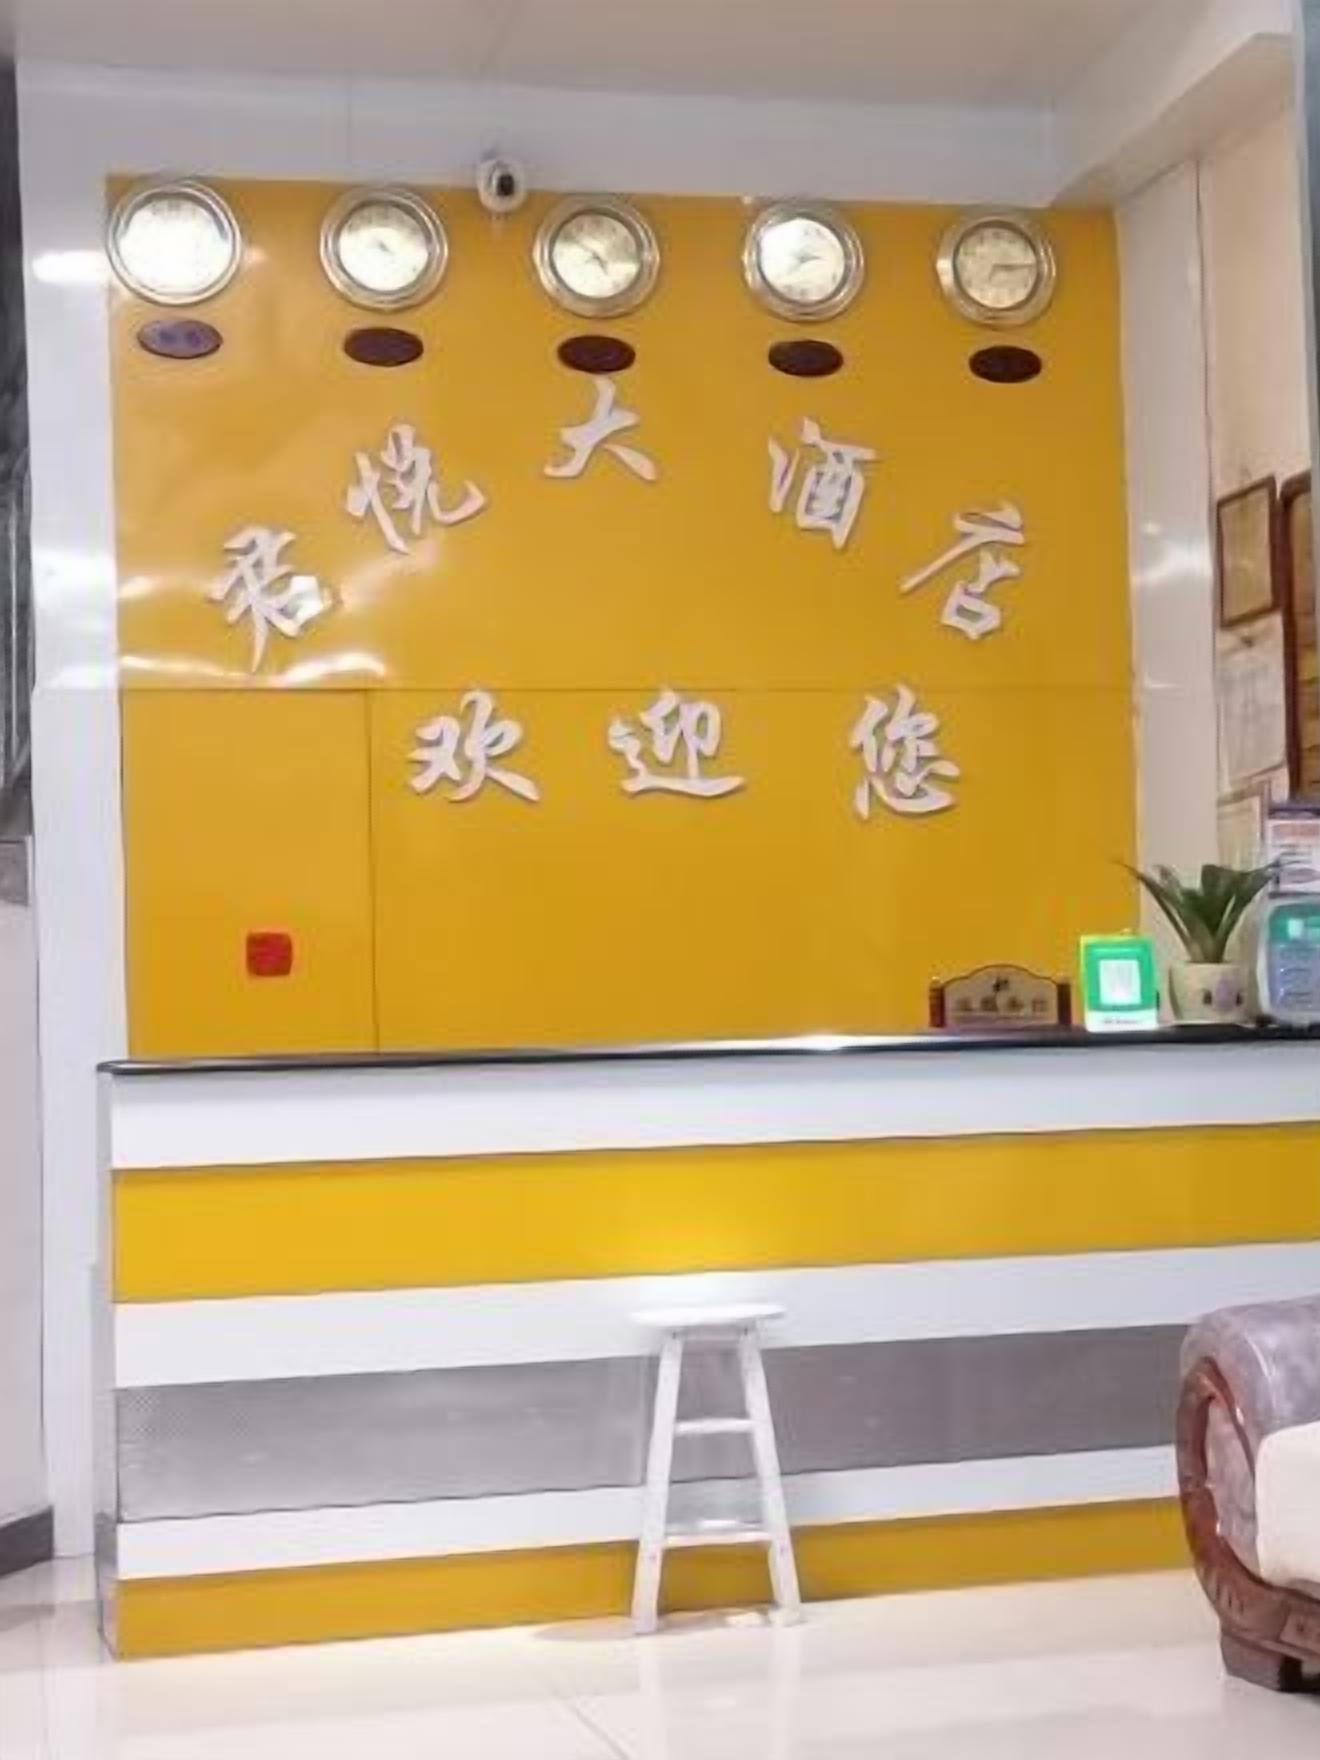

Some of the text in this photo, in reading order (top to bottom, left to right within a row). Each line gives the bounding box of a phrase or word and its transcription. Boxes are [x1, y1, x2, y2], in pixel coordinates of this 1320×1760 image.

[205, 377, 1027, 673] 君悦大酒店
[408, 684, 959, 820] 欢迎您
